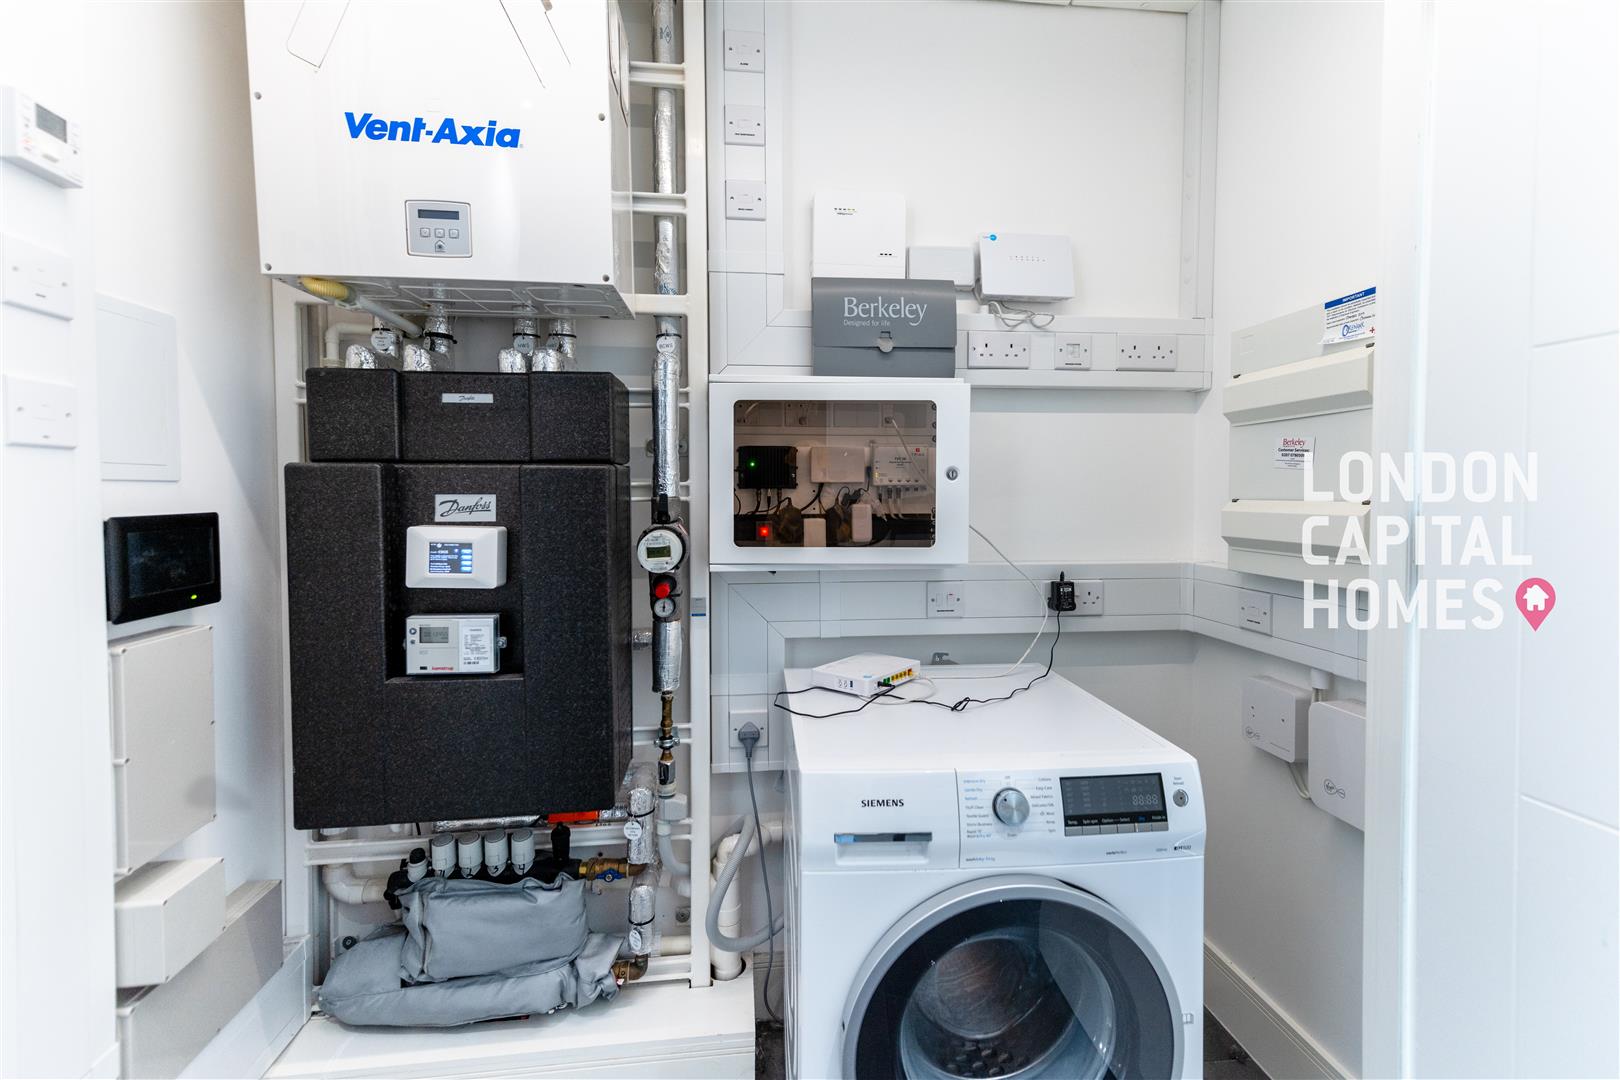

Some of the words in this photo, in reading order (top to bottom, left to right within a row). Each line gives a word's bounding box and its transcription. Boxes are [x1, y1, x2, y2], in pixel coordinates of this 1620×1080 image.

[344, 111, 521, 148] Vent-Axia
[843, 296, 928, 326] Berkeley
[439, 497, 492, 517] Danfoss
[861, 799, 905, 808] SIEMENS
